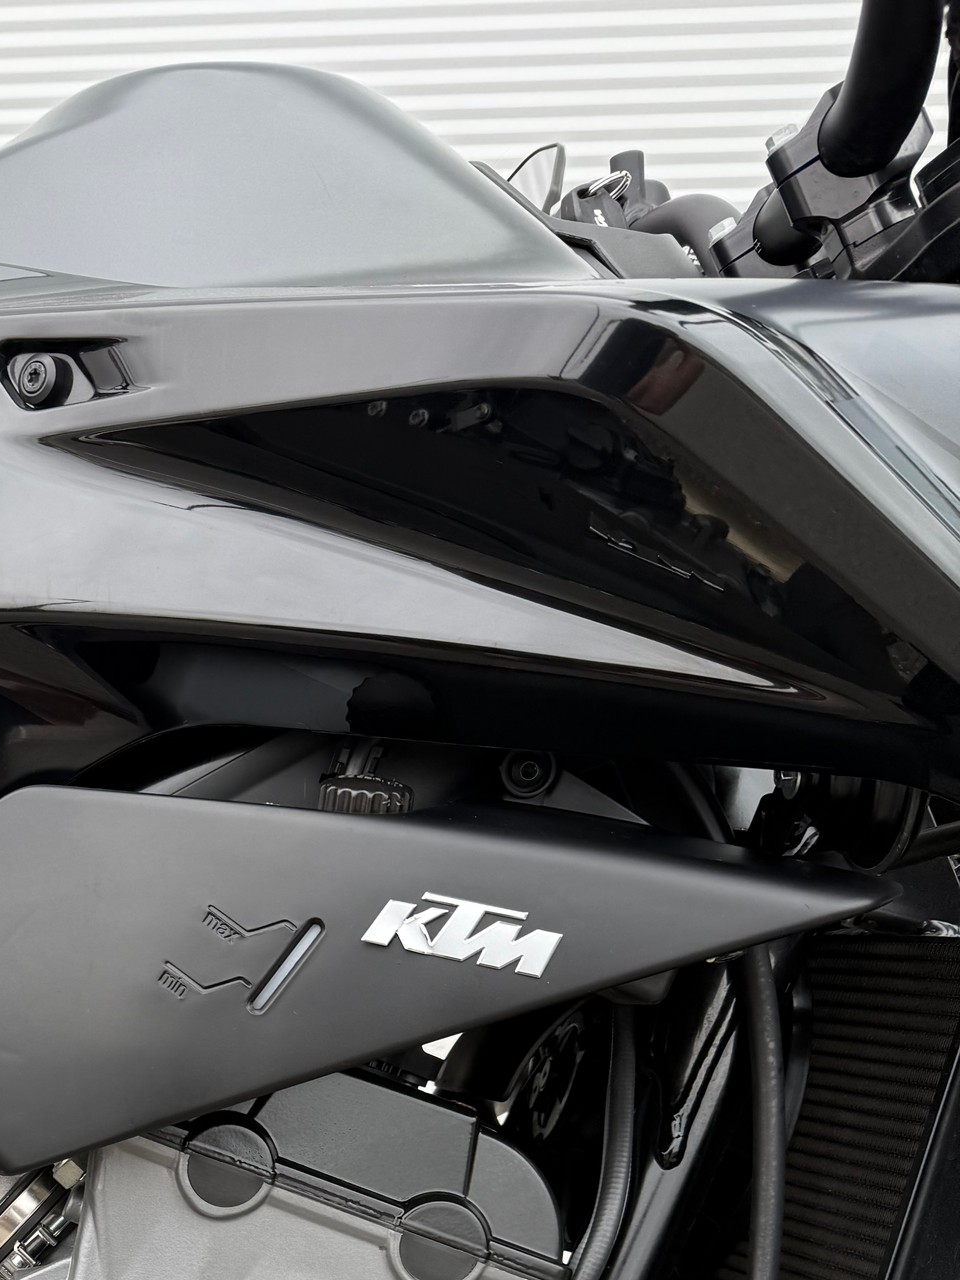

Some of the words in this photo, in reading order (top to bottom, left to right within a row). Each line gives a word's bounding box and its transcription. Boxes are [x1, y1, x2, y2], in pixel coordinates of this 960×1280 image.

[201, 911, 240, 945] max
[360, 891, 564, 979] KTM
[157, 969, 188, 1001] min
